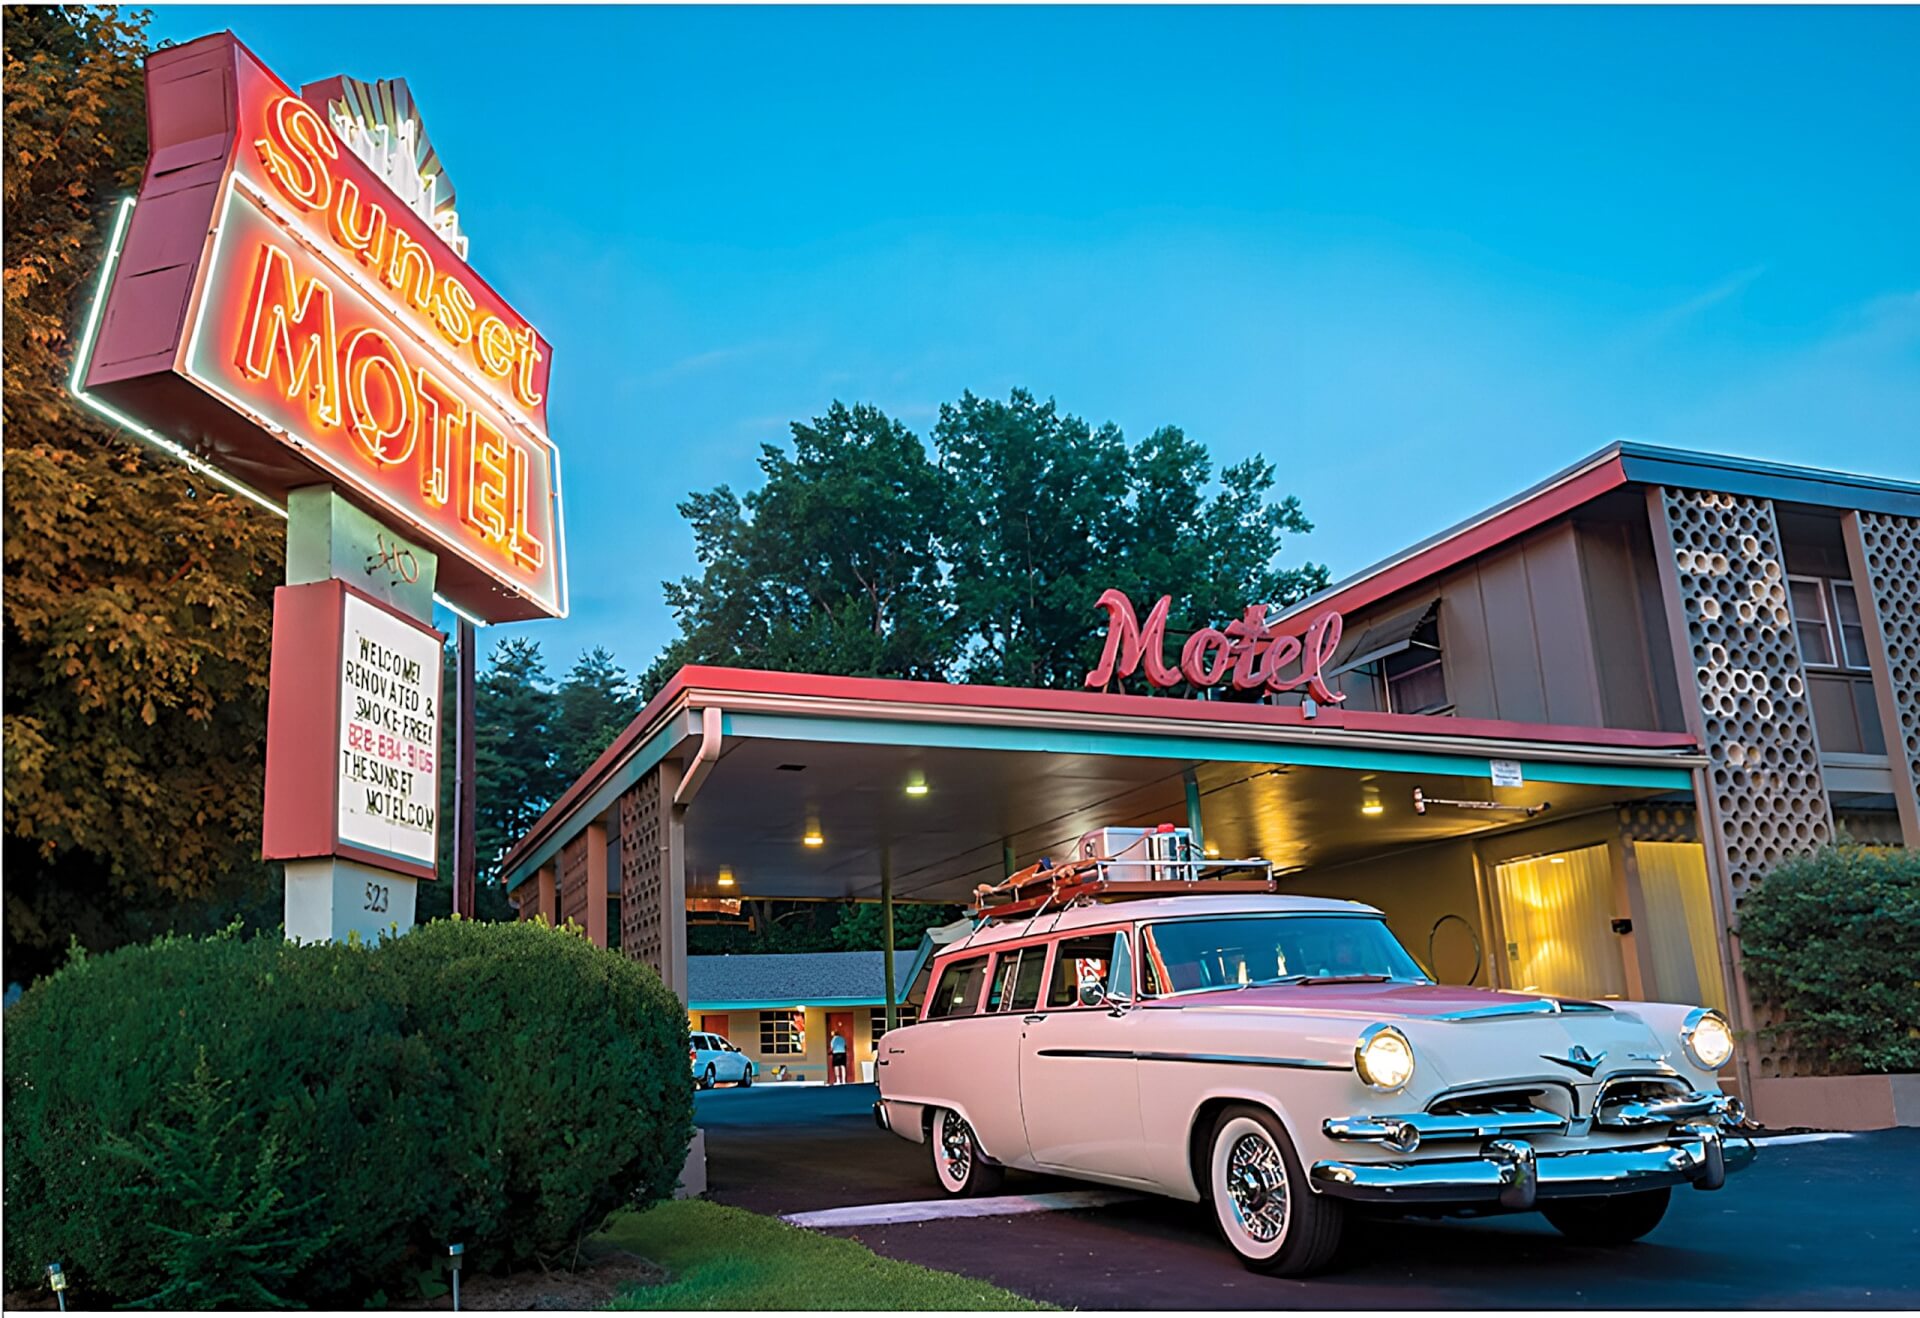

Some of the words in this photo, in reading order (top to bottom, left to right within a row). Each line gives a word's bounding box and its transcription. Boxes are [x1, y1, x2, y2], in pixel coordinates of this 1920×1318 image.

[252, 96, 543, 406] Sunset
[234, 243, 544, 572] MOTEL
[345, 659, 420, 712] RENOVATED
[425, 697, 436, 721] &
[359, 635, 420, 686] WELCOME!
[1084, 588, 1347, 704] Motel
[363, 881, 389, 913] 523
